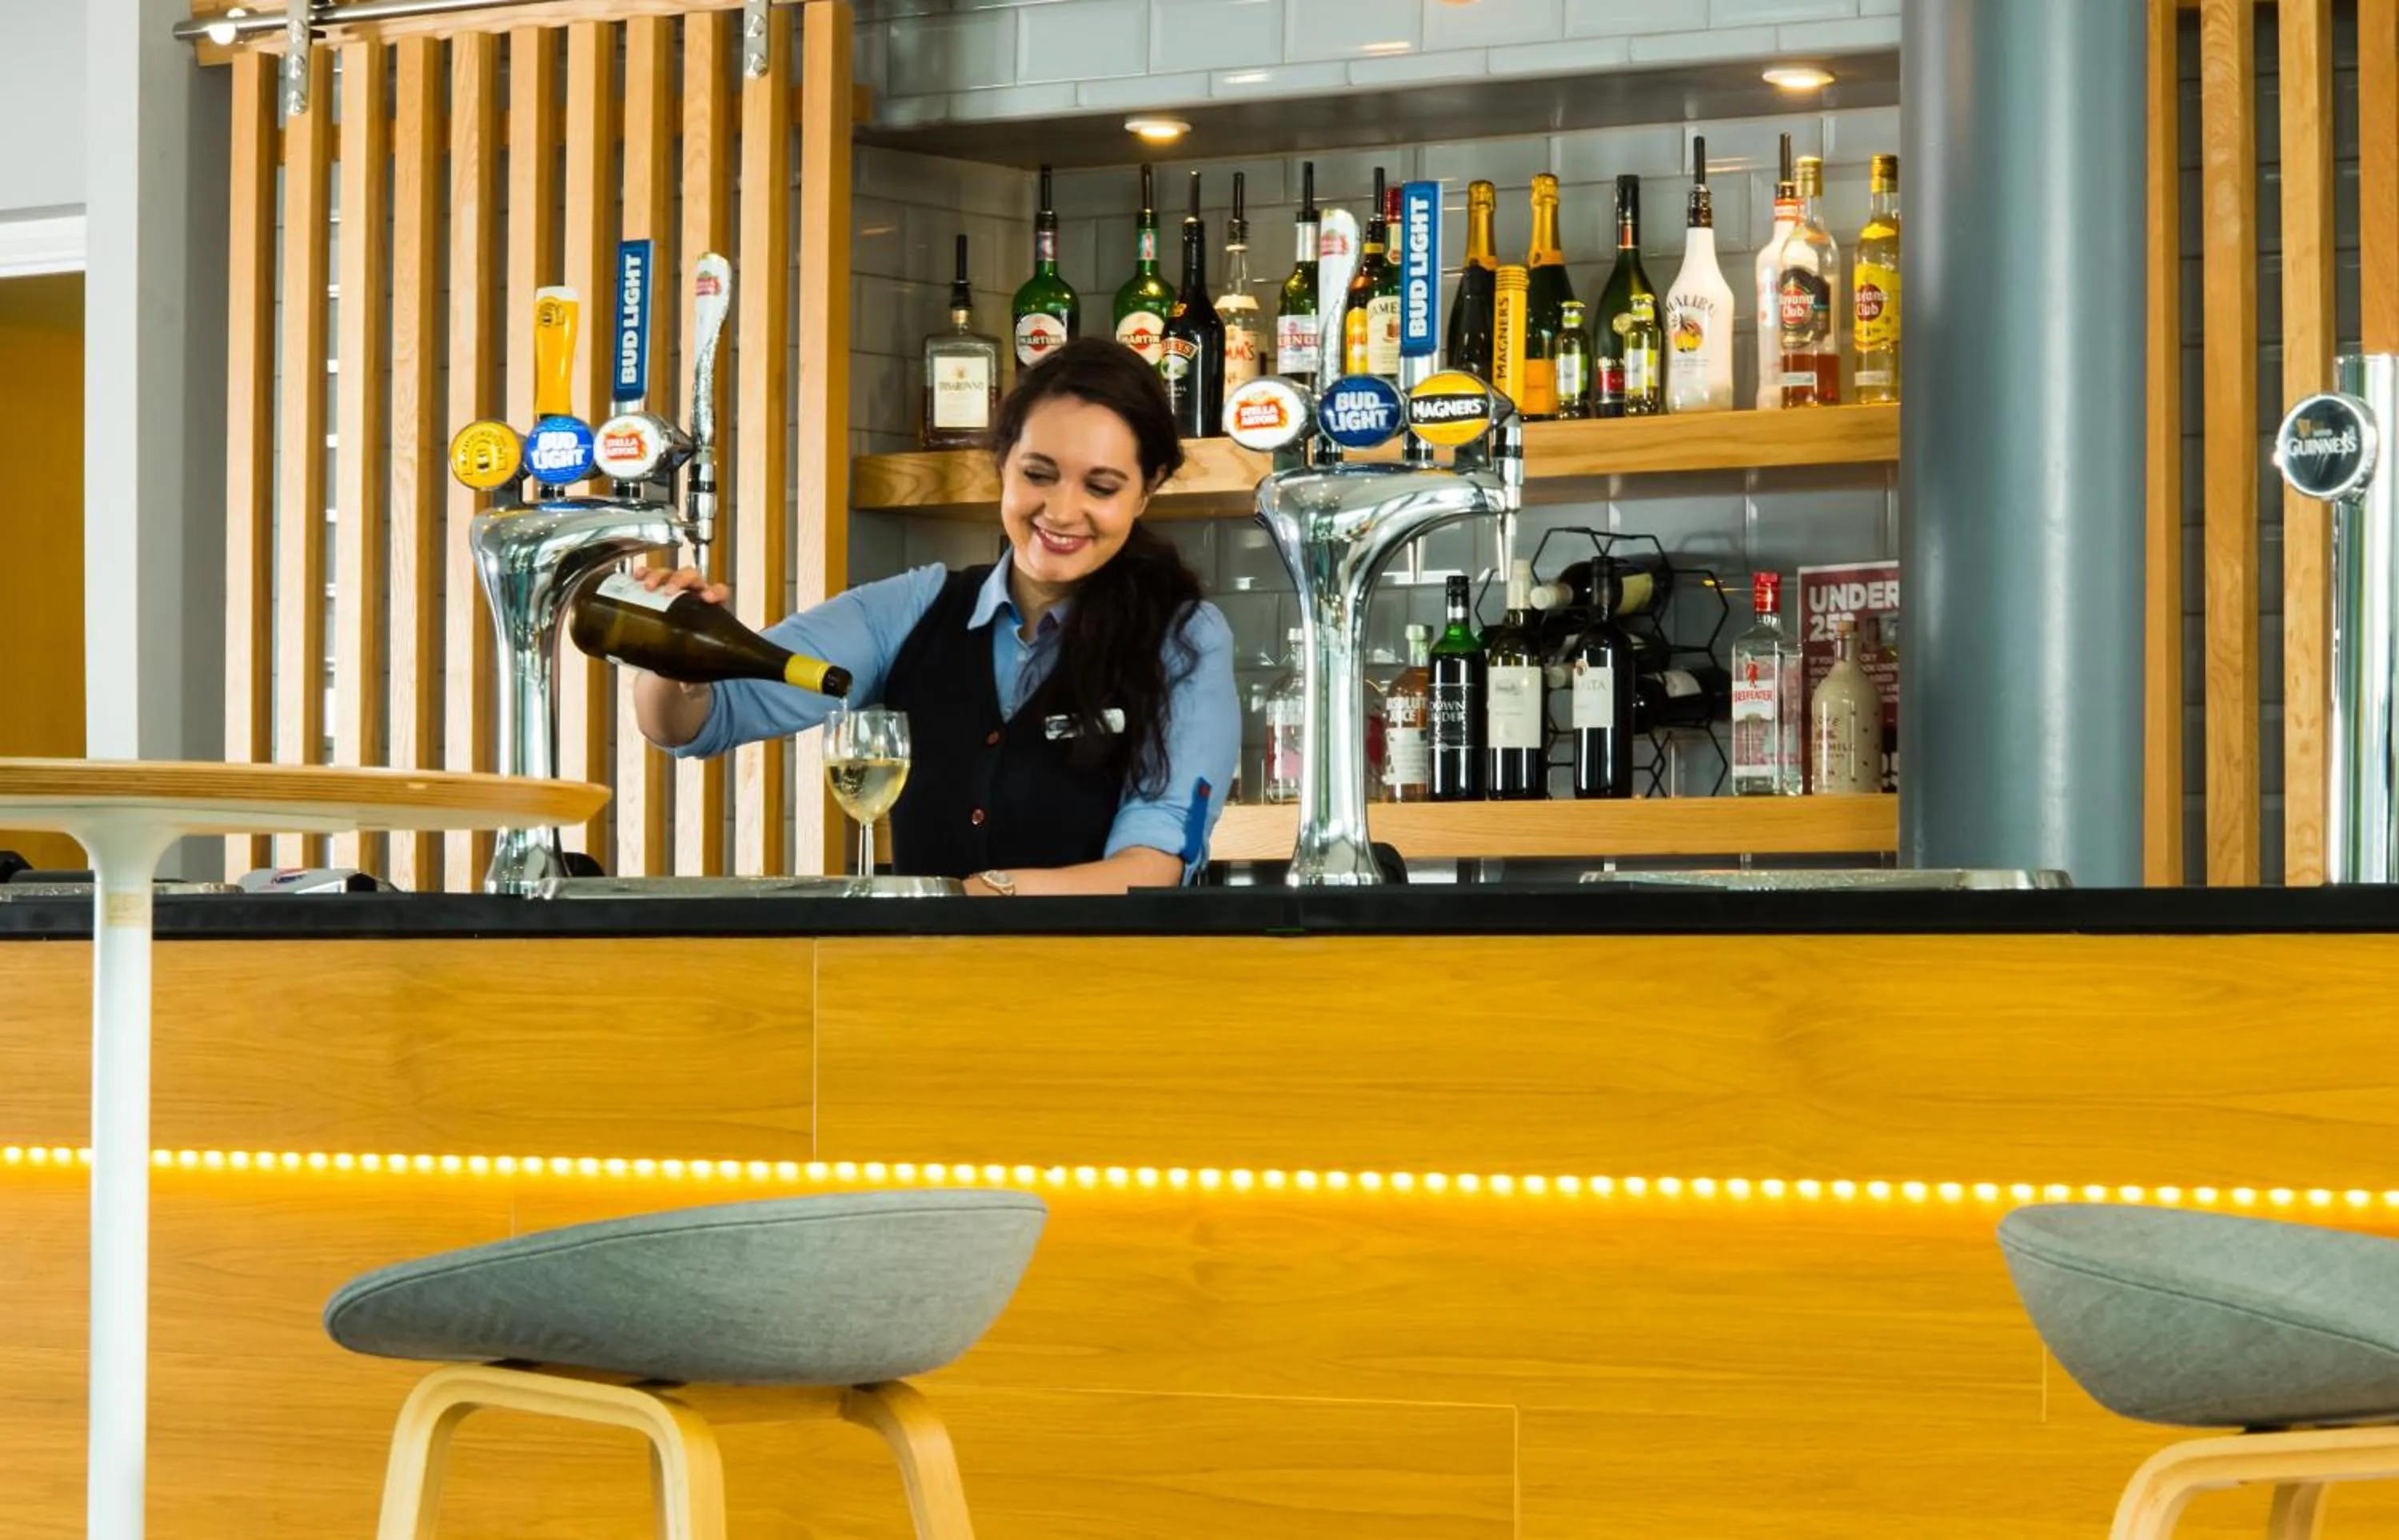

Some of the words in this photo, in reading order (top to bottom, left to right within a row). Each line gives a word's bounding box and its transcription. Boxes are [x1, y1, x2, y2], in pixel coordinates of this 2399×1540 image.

[1409, 196, 1430, 277] LIGHT
[623, 253, 642, 328] LIGHT
[1409, 279, 1429, 337] BUD
[1497, 297, 1509, 380] MAGNERS
[621, 329, 638, 385] BUD
[1335, 391, 1379, 412] BUD
[1412, 399, 1482, 419] MAGNERS
[1326, 409, 1388, 432] LIGHT
[538, 432, 578, 449] BUD
[2287, 437, 2358, 457] GUINNESS
[531, 448, 585, 469] LIGHT
[1809, 581, 1899, 612] UNDER
